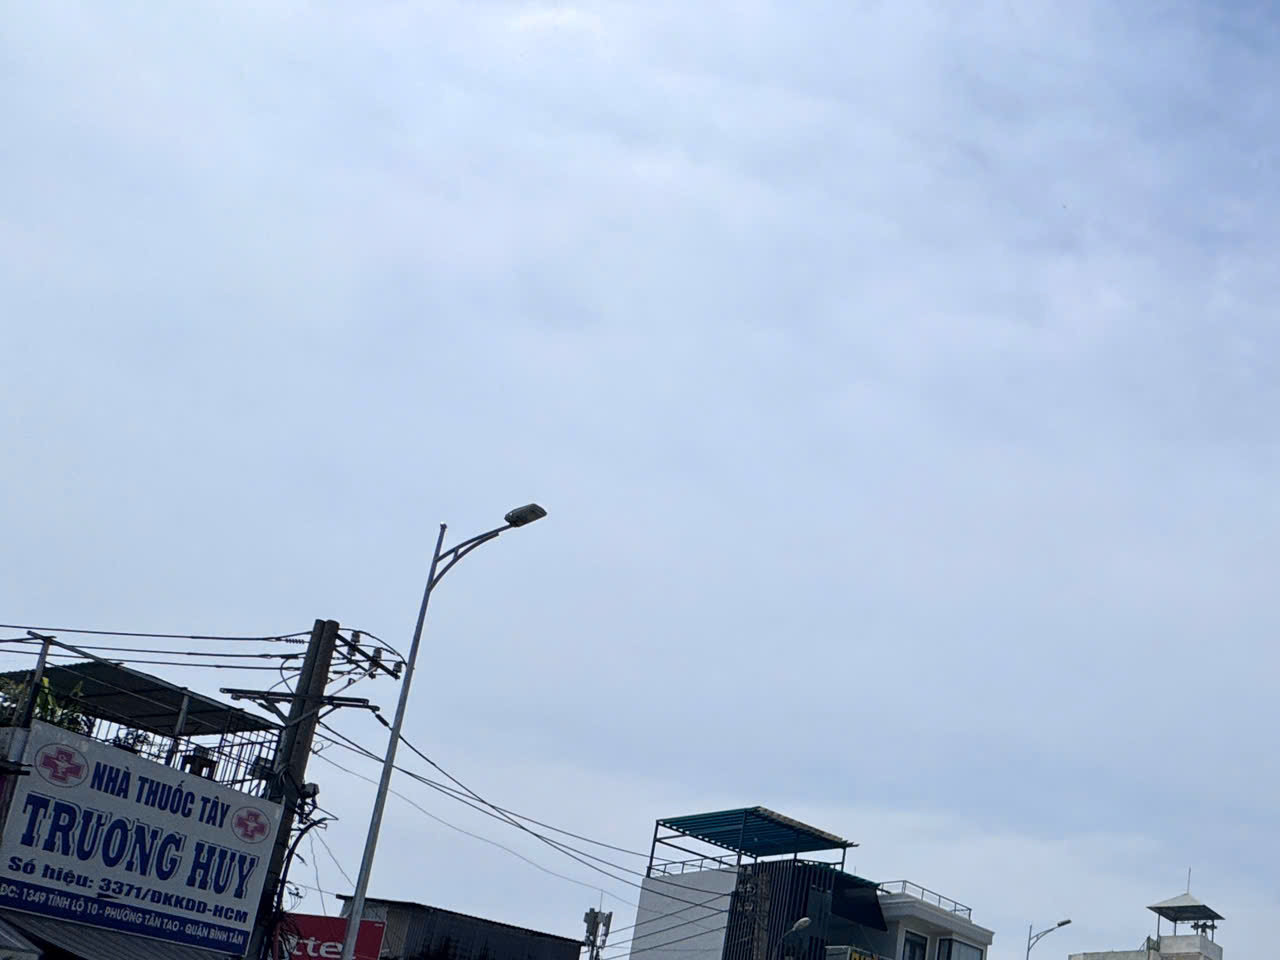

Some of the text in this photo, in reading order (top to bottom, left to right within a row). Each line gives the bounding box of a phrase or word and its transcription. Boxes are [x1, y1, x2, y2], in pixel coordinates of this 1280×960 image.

[90, 761, 231, 829] NHÀ THUỐC TÂY
[8, 856, 37, 875] Số
[41, 863, 94, 889] hiệu:
[186, 839, 260, 900] HUY
[22, 888, 46, 904] 1349
[71, 899, 85, 915] LỘ
[87, 902, 98, 915] 10
[104, 905, 144, 926] PHƯỜNG
[144, 912, 161, 927] TÂN
[162, 918, 180, 933] TẠO
[185, 922, 208, 940] QUẬN
